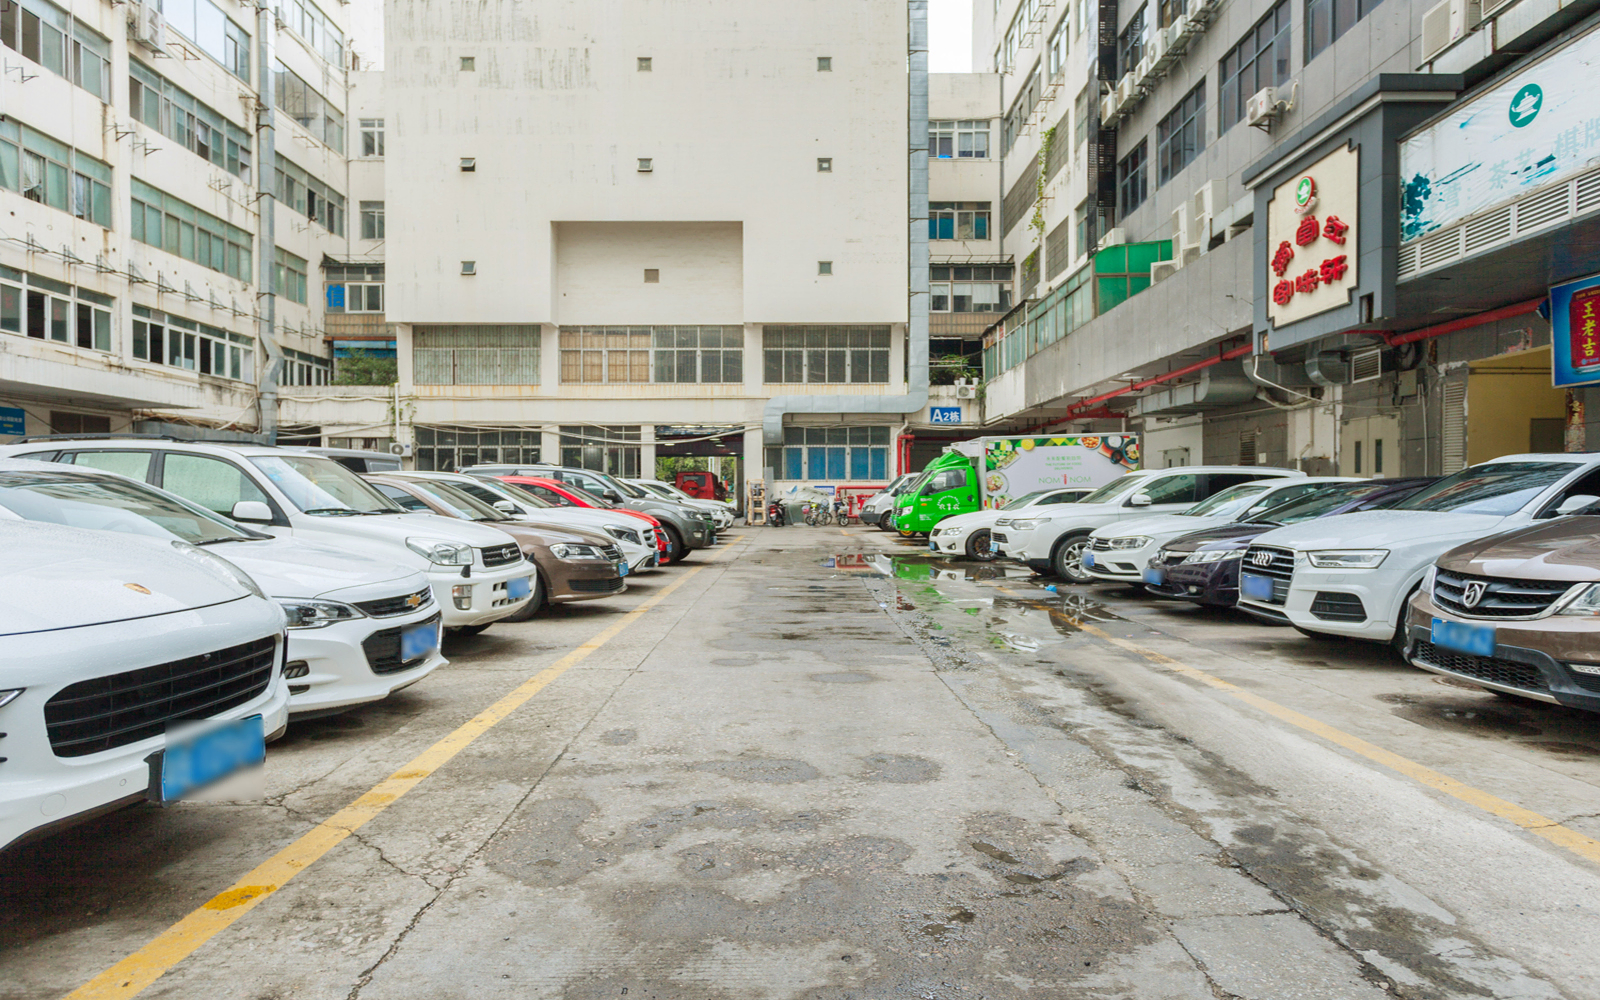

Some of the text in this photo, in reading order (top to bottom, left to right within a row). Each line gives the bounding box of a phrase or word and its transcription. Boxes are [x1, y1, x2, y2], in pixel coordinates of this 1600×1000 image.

[1273, 255, 1348, 305] 客味轩
[326, 285, 345, 308] 信
[1582, 301, 1596, 357] 王老吉
[932, 409, 960, 423] A2栋
[1038, 475, 1091, 485] NOM NOM
